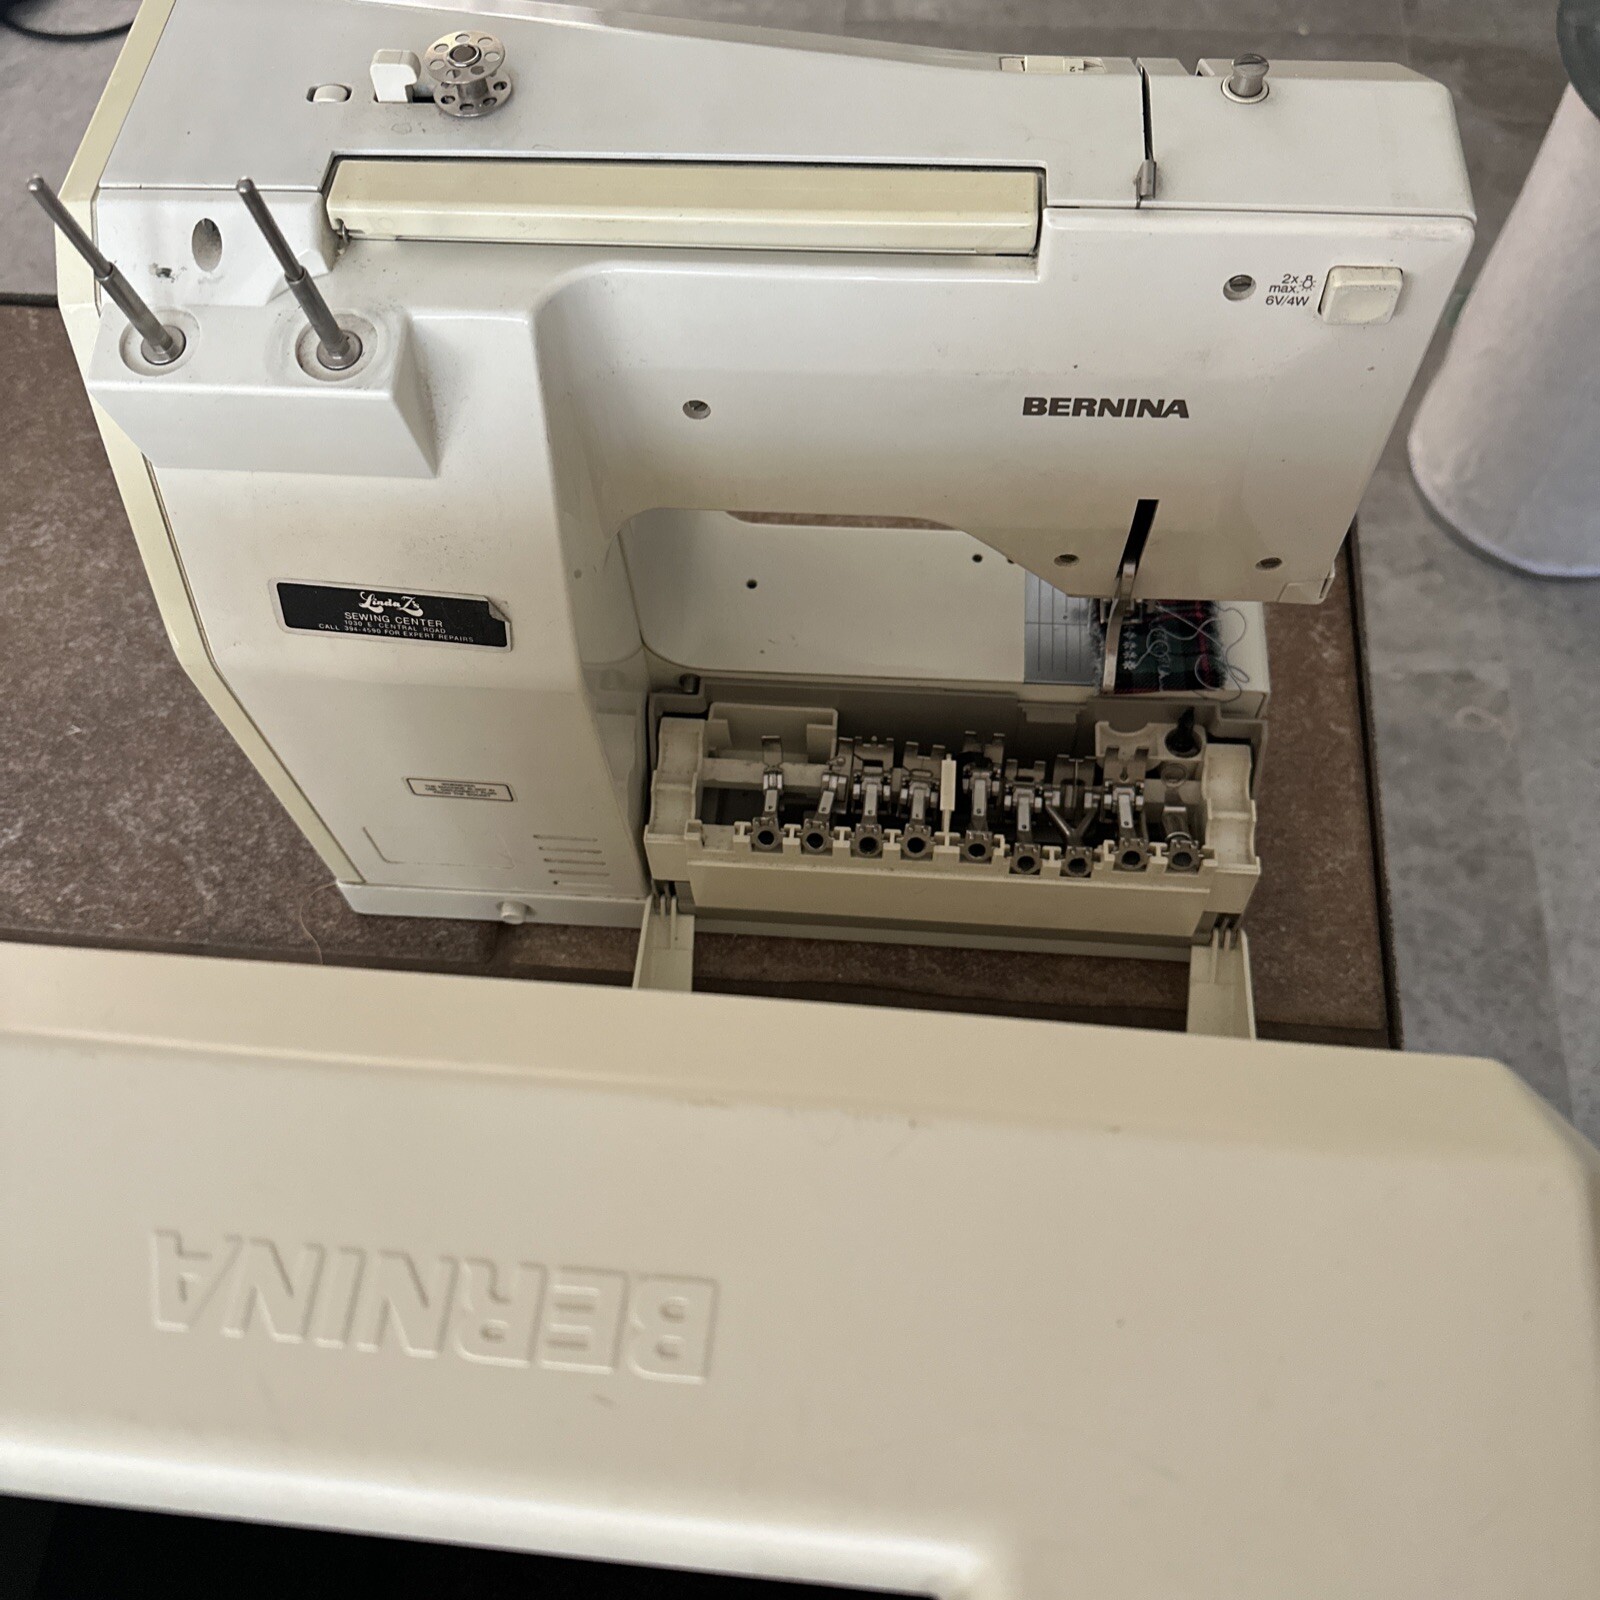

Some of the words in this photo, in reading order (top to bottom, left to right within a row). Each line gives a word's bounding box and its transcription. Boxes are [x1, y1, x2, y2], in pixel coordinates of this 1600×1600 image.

[1282, 273, 1299, 284] 2x
[1268, 285, 1300, 293] max.
[1265, 295, 1309, 306] 6V/4W
[1022, 397, 1190, 418] BERNINA
[359, 591, 401, 614] Linda
[344, 611, 390, 623] SEWING
[395, 616, 443, 628] CENTER
[378, 622, 417, 632] CENTRAL
[423, 626, 446, 634] ROAD
[344, 625, 381, 634] 394-4590
[384, 628, 401, 636] FOR
[403, 630, 435, 639] EXPERT
[438, 633, 474, 643] REPAIRS
[152, 1228, 720, 1386] BERNINA
